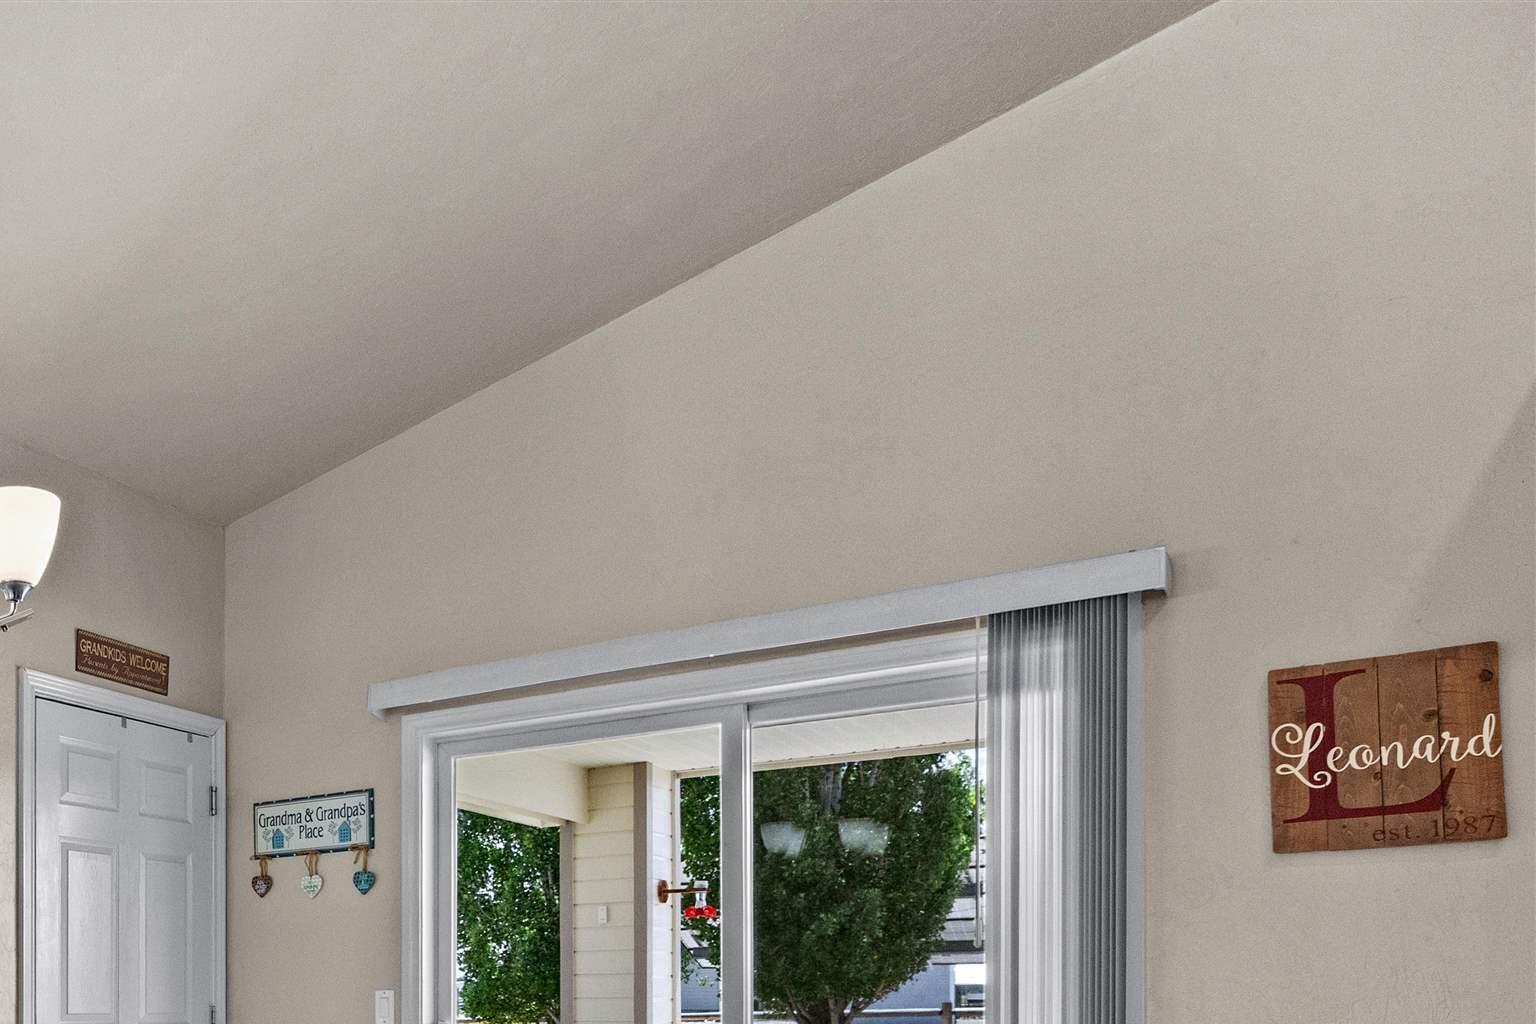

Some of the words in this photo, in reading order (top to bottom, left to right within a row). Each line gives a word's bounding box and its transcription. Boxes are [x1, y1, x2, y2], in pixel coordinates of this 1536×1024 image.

[80, 639, 126, 663] GRANDKIDS
[129, 652, 168, 675] WELCOME
[1271, 713, 1503, 788] Leonard
[1276, 668, 1456, 824] L
[258, 811, 302, 828] Grandma
[304, 808, 314, 823] &
[316, 802, 366, 822] Grandpa's
[1372, 821, 1421, 841] est.
[1431, 814, 1497, 839] 1987
[299, 825, 323, 839] Place
